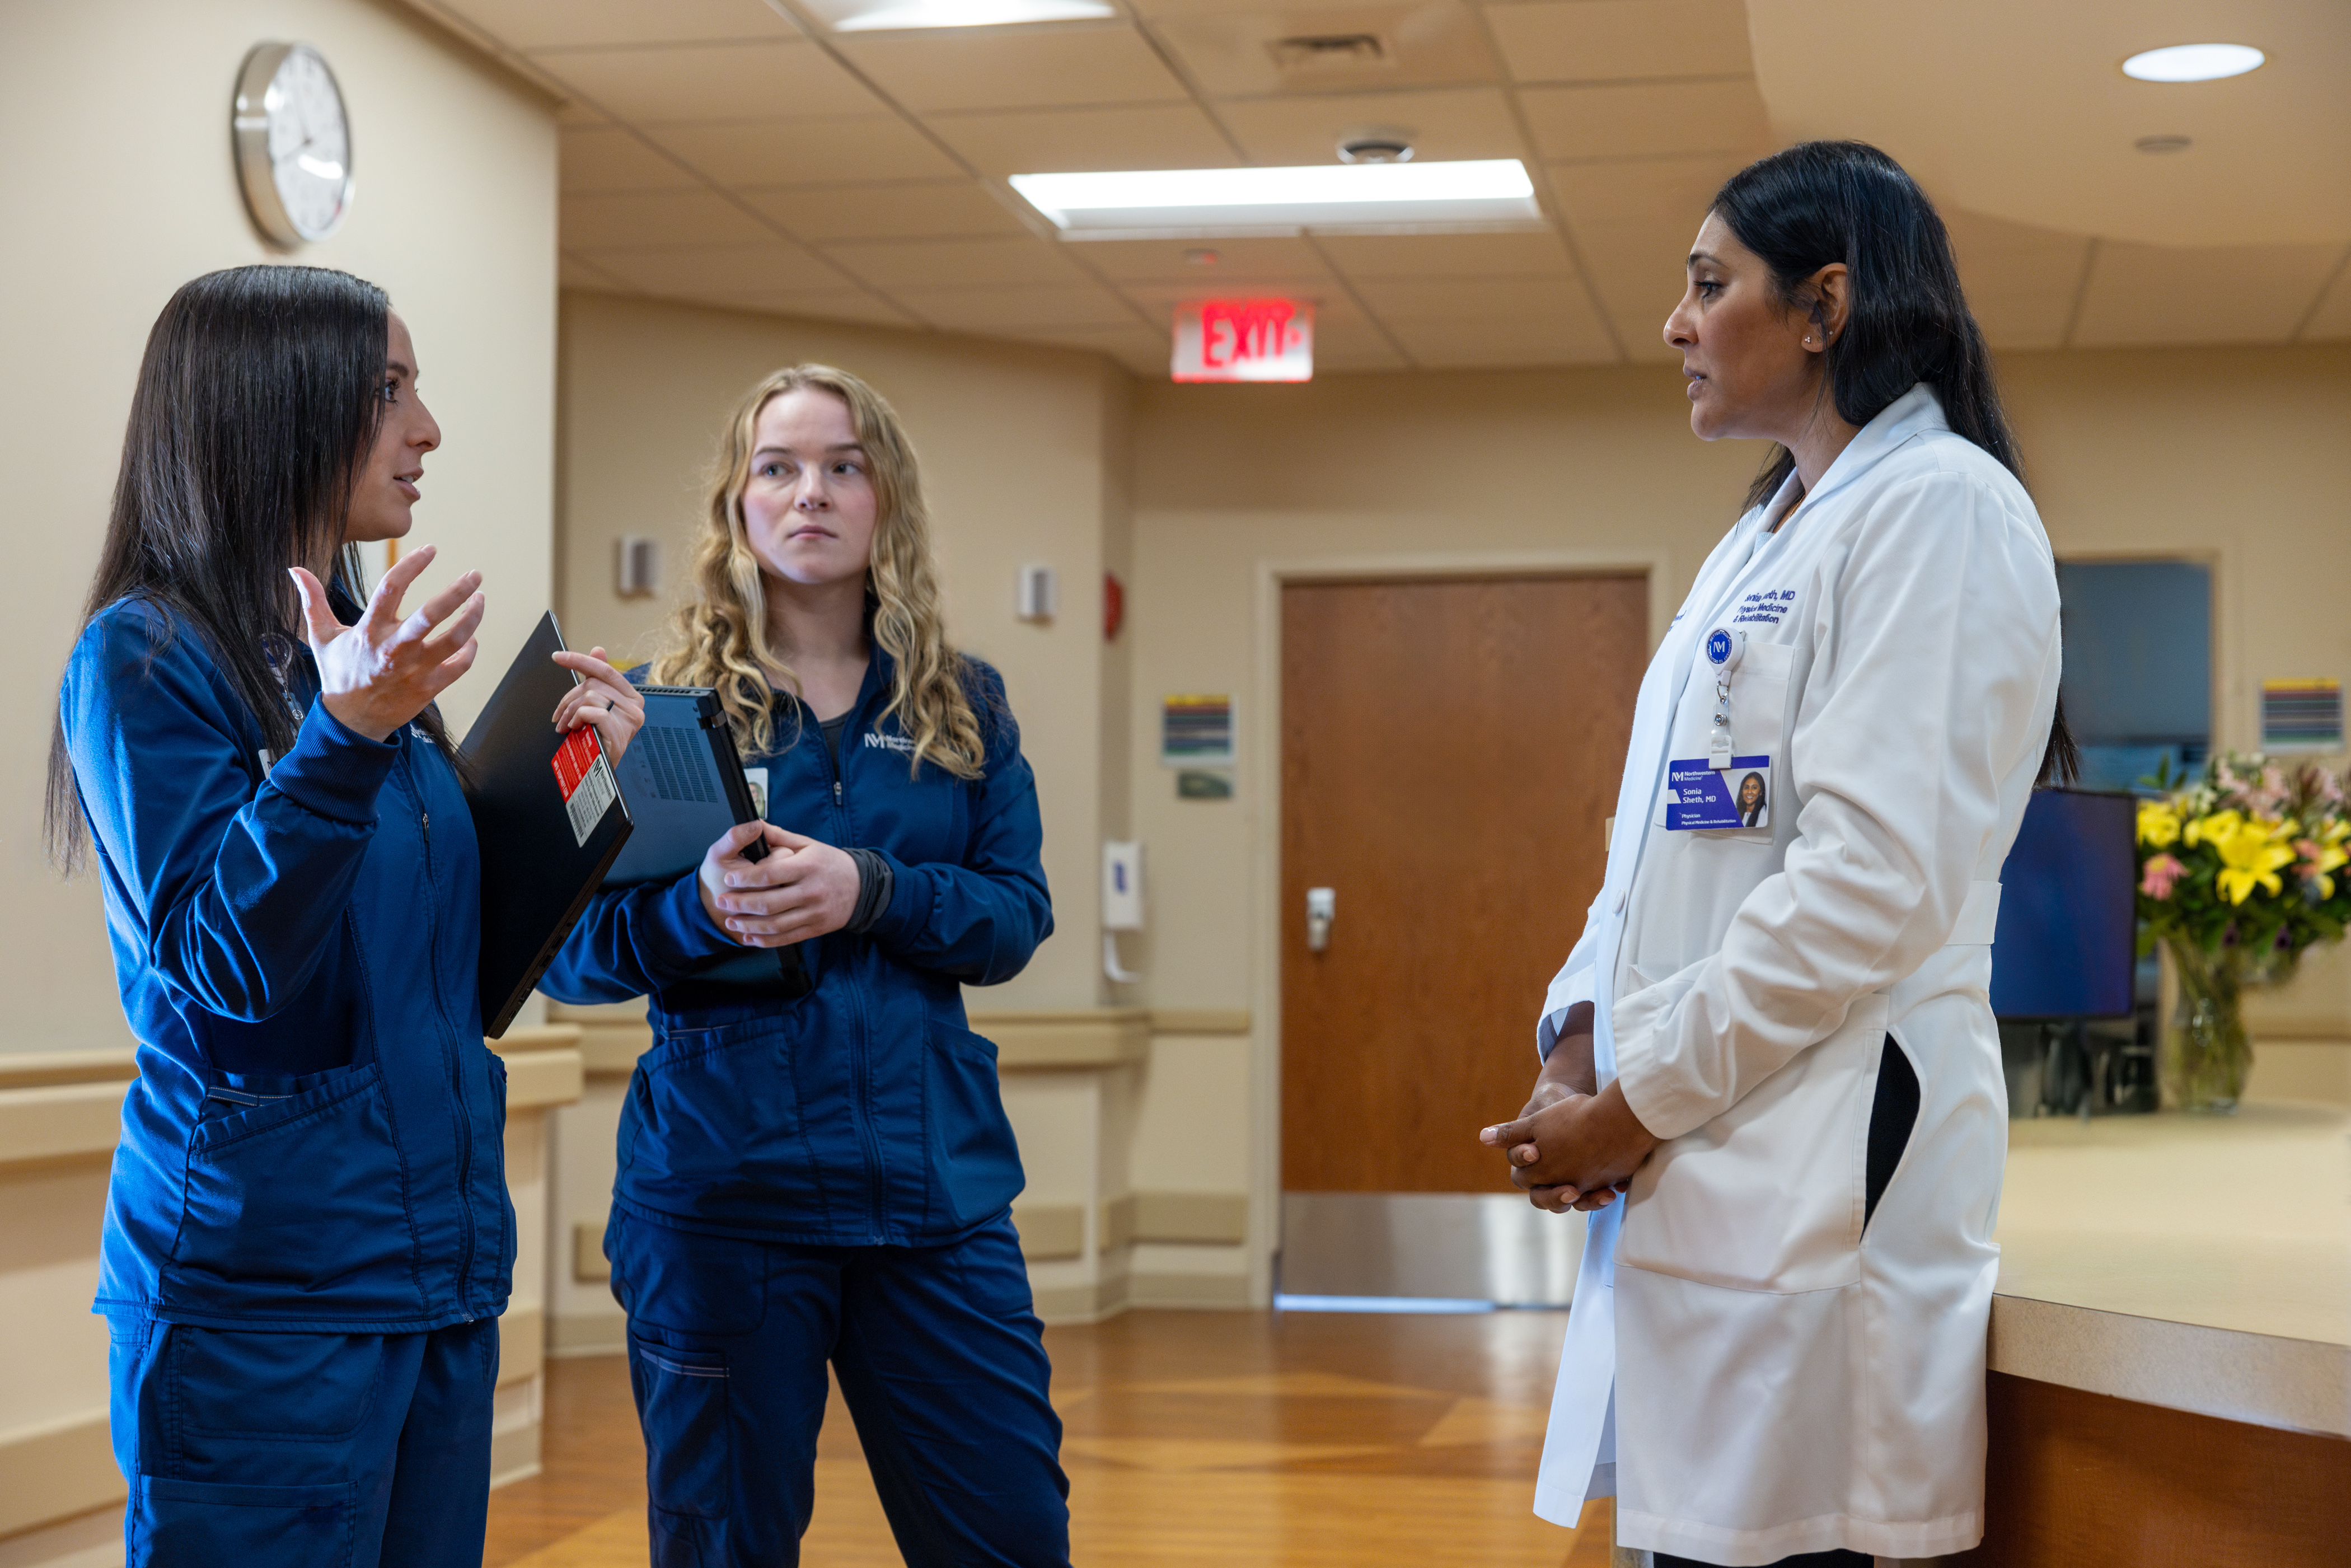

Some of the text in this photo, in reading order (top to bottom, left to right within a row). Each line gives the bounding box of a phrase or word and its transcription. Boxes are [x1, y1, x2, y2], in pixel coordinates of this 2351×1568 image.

[1202, 303, 1294, 367] EXIT
[1780, 590, 1795, 601] MD
[1758, 603, 1787, 613] Medicine
[600, 769, 613, 801] Northwestern
